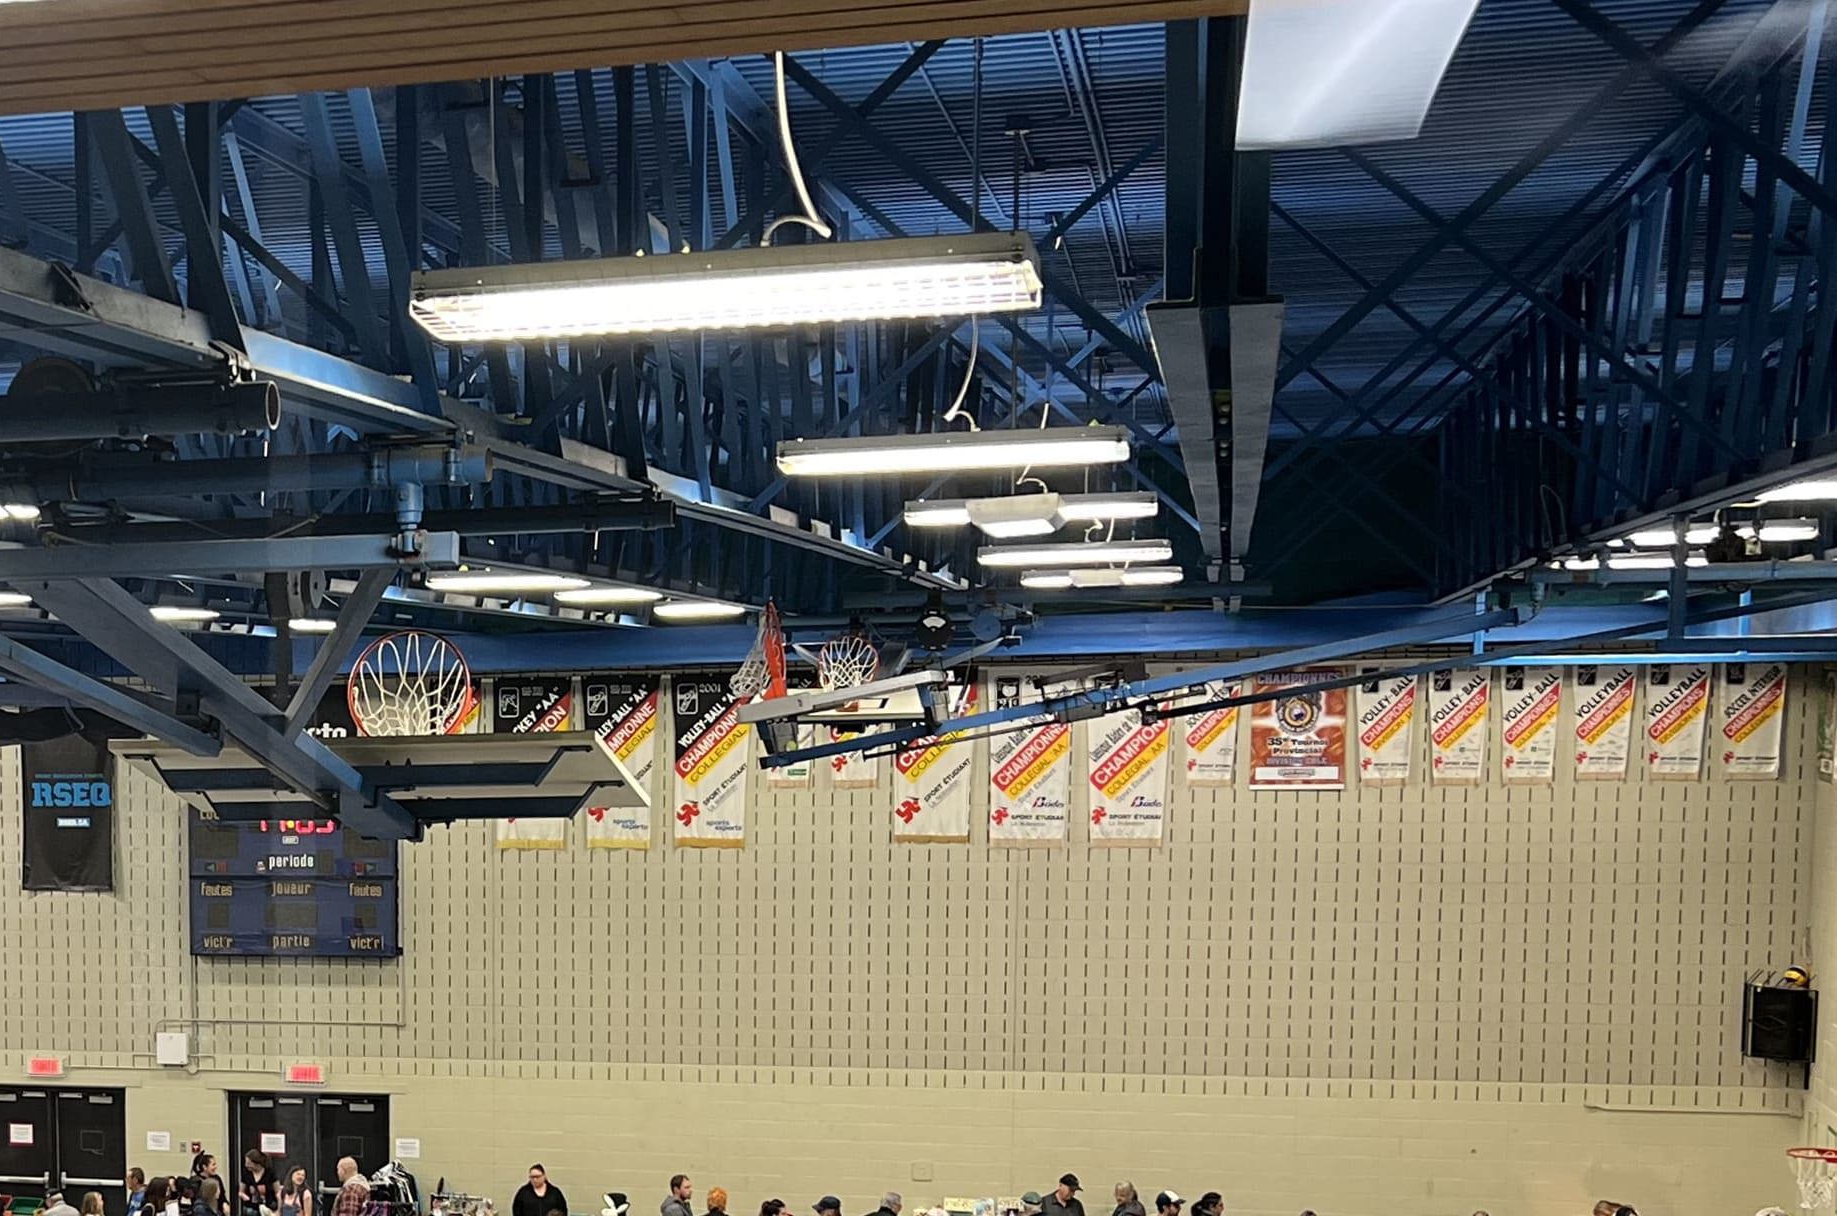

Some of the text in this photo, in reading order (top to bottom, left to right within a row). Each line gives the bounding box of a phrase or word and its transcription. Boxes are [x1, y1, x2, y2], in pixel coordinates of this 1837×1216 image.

[1575, 668, 1633, 719] VOLLEYBALL
[1648, 668, 1706, 718] VOLLEYBALL
[1650, 688, 1704, 737] CHAMPIONS
[607, 702, 656, 751] MPIONNE
[31, 782, 112, 808] RSEQ
[271, 881, 312, 897] joueur
[272, 935, 310, 948] partie
